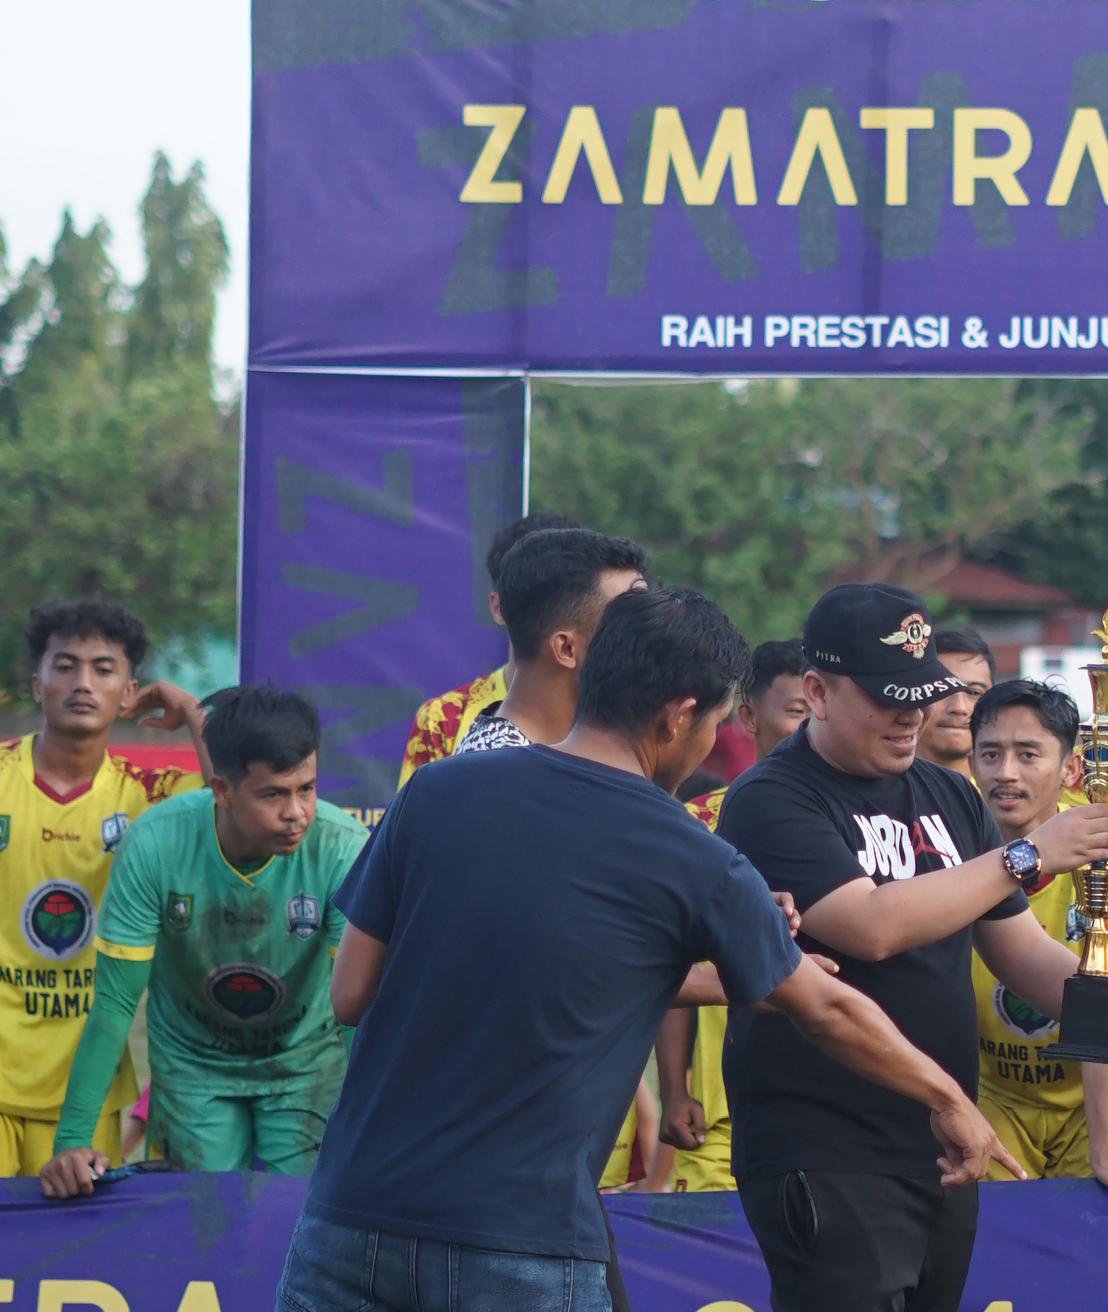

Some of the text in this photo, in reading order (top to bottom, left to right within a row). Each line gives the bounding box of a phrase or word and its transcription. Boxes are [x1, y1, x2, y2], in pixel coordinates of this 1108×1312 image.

[662, 315, 752, 348] RAIH
[765, 316, 948, 348] PRESTASI
[962, 317, 988, 349] &
[883, 680, 949, 702] CORPS
[979, 1037, 1029, 1061] ARANG
[997, 1060, 1066, 1085] UTAMA
